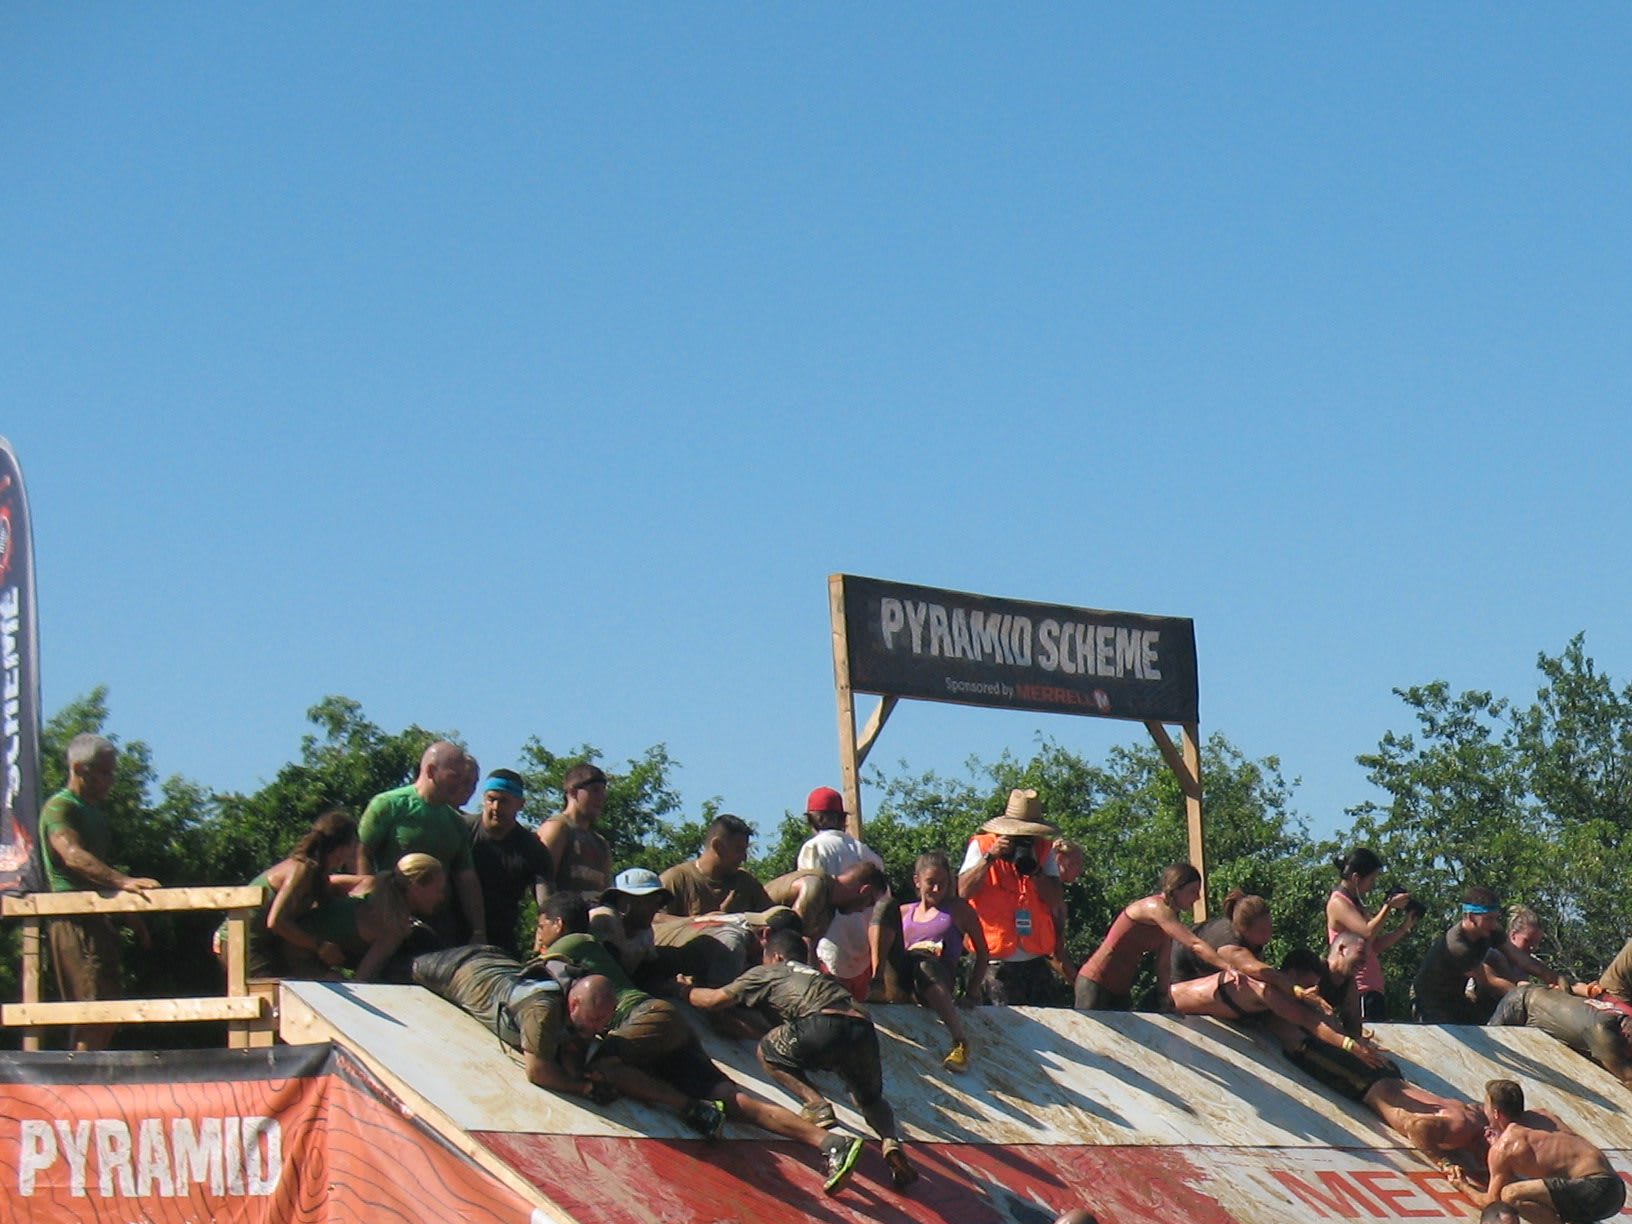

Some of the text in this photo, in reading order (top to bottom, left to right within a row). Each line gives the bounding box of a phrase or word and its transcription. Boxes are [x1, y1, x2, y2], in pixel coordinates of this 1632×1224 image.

[880, 596, 1162, 681] PYRAMID SCHEME
[945, 676, 1000, 695] Sponsored
[1001, 681, 1016, 699] by
[19, 1116, 282, 1197] PYRAMID
